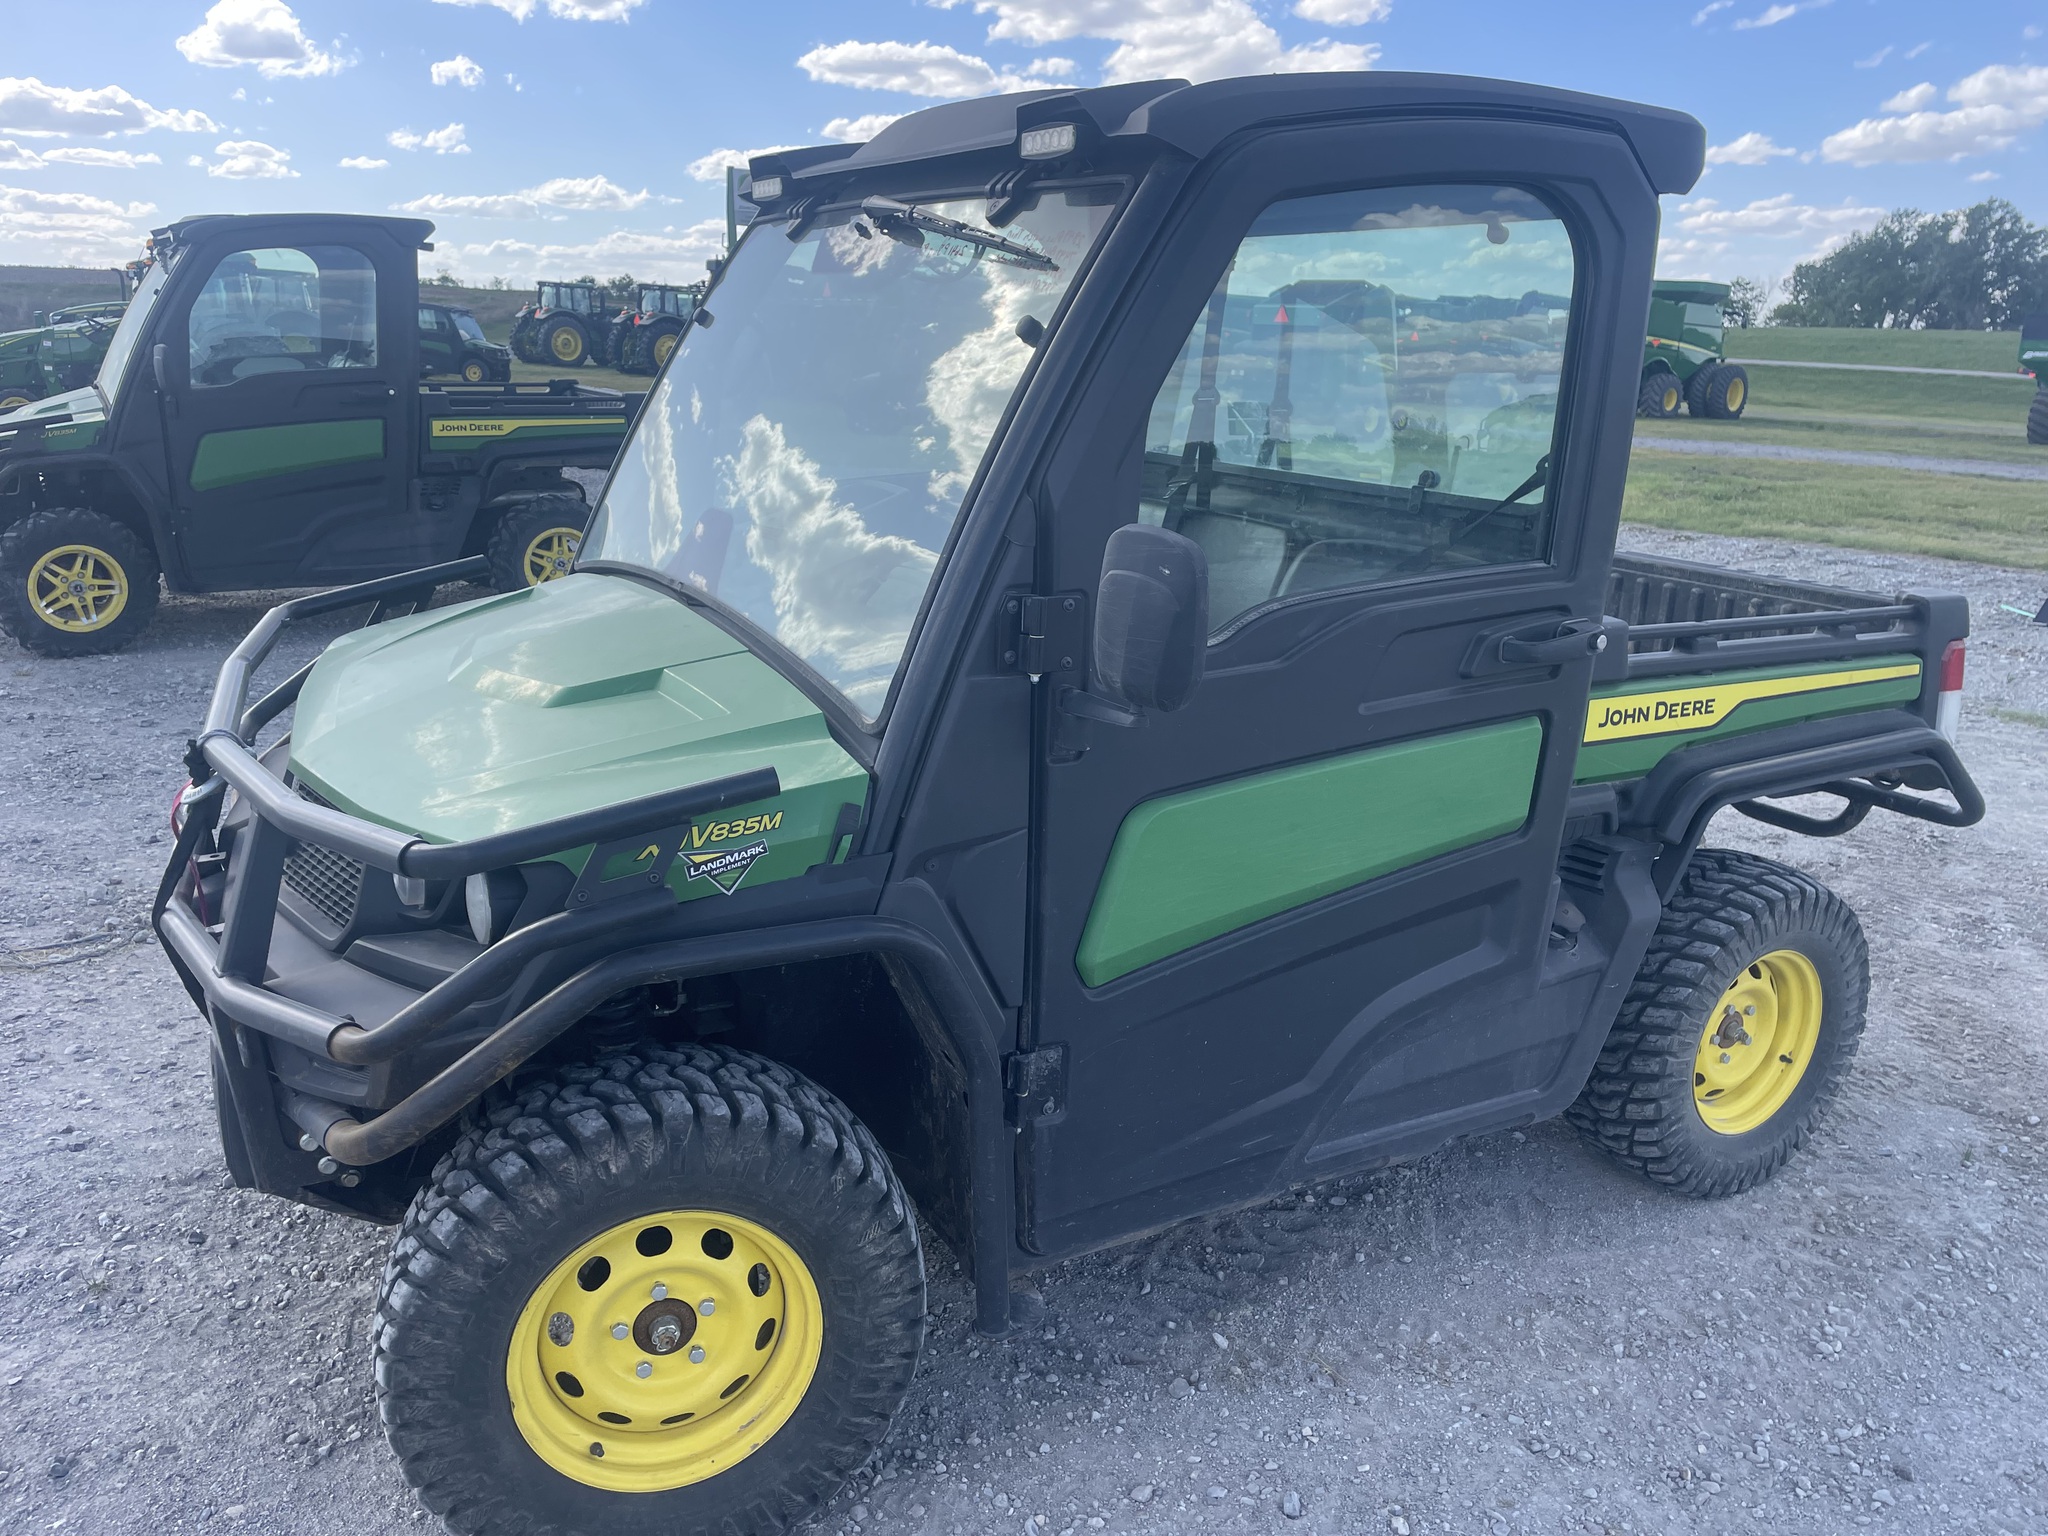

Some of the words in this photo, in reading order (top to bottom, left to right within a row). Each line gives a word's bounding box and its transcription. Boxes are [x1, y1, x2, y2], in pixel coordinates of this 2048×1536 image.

[439, 423, 467, 432] JOHN
[469, 423, 504, 431] DEERE
[1598, 705, 1650, 728] JOHN
[1654, 698, 1716, 721] DEERE
[690, 844, 765, 876] LANDMARK
[710, 858, 751, 876] IMPLEMENT
